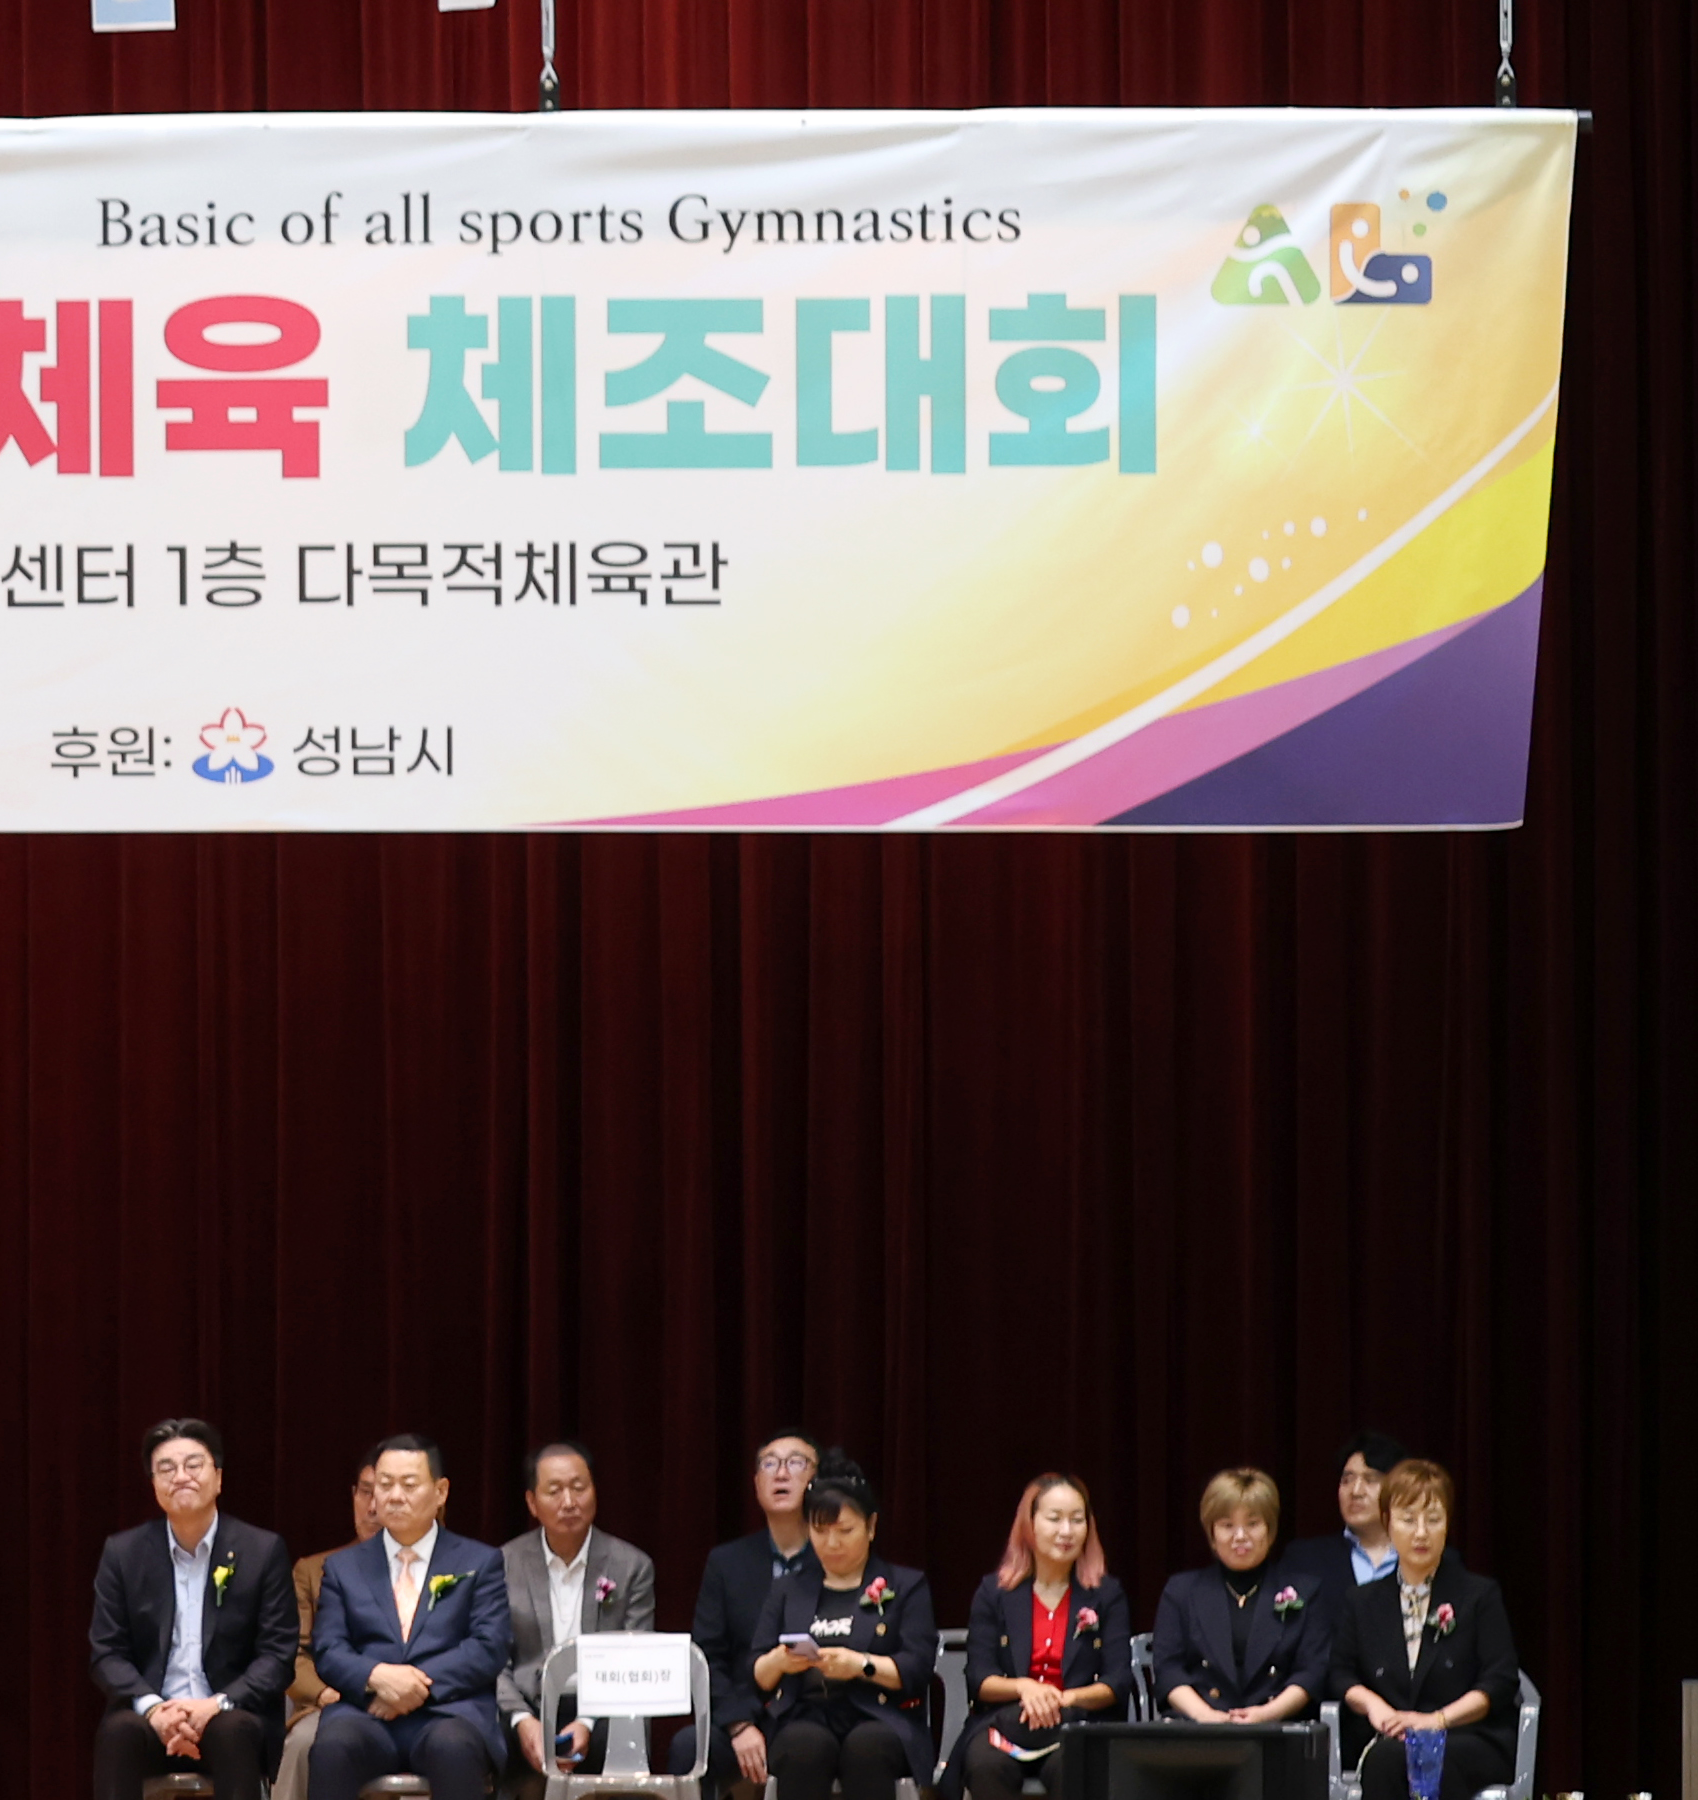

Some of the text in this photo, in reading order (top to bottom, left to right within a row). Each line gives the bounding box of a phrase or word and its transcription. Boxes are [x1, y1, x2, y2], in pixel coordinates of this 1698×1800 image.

[97, 191, 1022, 256] Basic of all sports Gymnastics
[404, 293, 1158, 475] 체조대회
[166, 540, 267, 608] 1층
[298, 540, 730, 607] 다목적체육관
[49, 726, 173, 779] 후원:
[291, 725, 454, 777] 성남시
